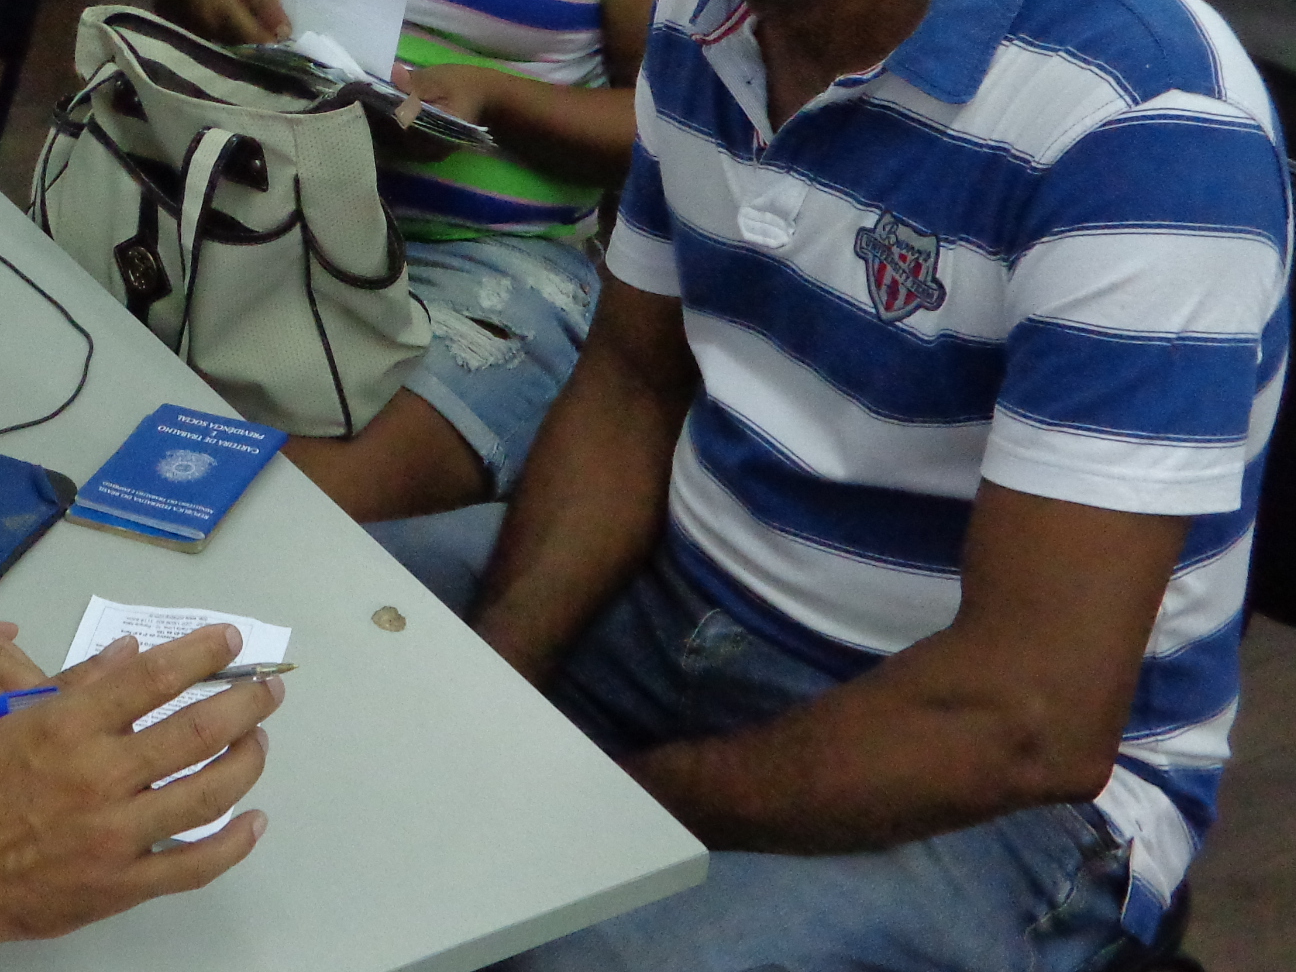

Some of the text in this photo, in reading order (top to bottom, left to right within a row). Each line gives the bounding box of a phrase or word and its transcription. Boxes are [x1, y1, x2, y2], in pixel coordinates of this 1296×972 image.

[157, 425, 260, 455] CARTEIRA DE TRABALHO
[177, 414, 265, 440] PREVIDÊNCIA SOCIAL
